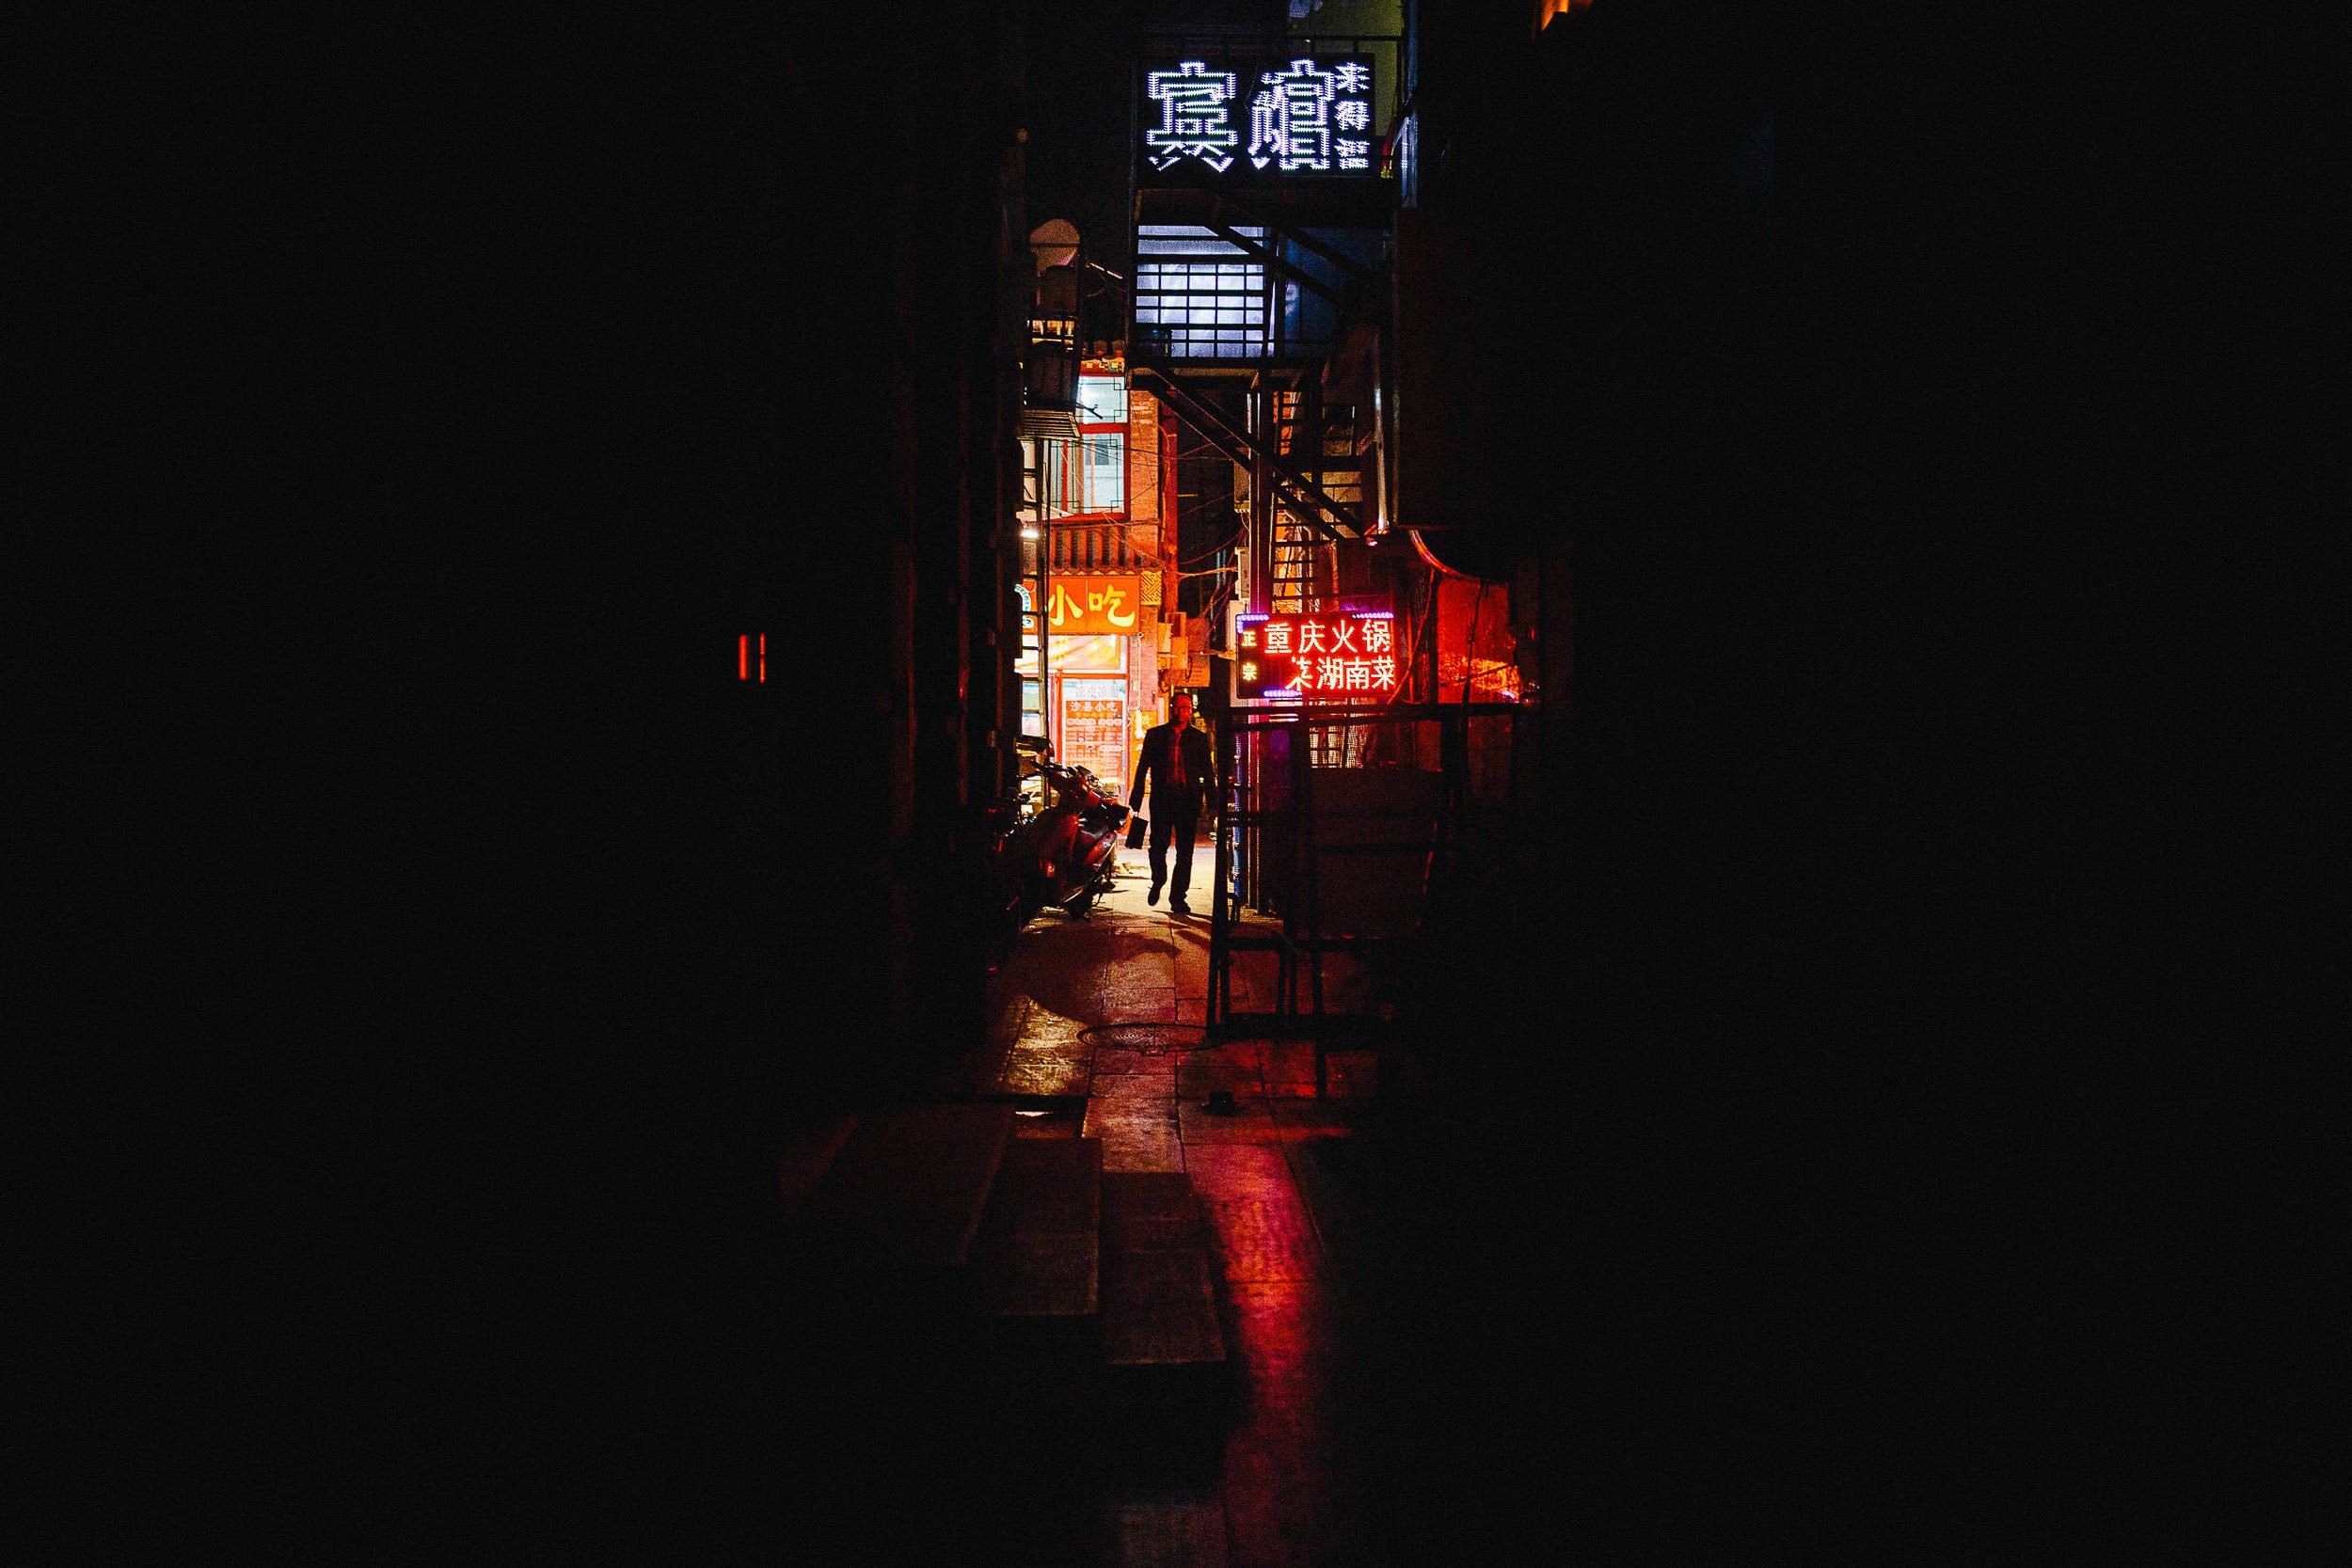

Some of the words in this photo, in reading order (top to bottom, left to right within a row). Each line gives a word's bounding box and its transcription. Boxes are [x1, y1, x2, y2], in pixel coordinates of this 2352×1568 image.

[1147, 60, 1334, 172] 宾馆
[1045, 583, 1136, 627] 小吃
[1241, 631, 1258, 682] 正宗
[1263, 620, 1391, 654] 重庆火锅
